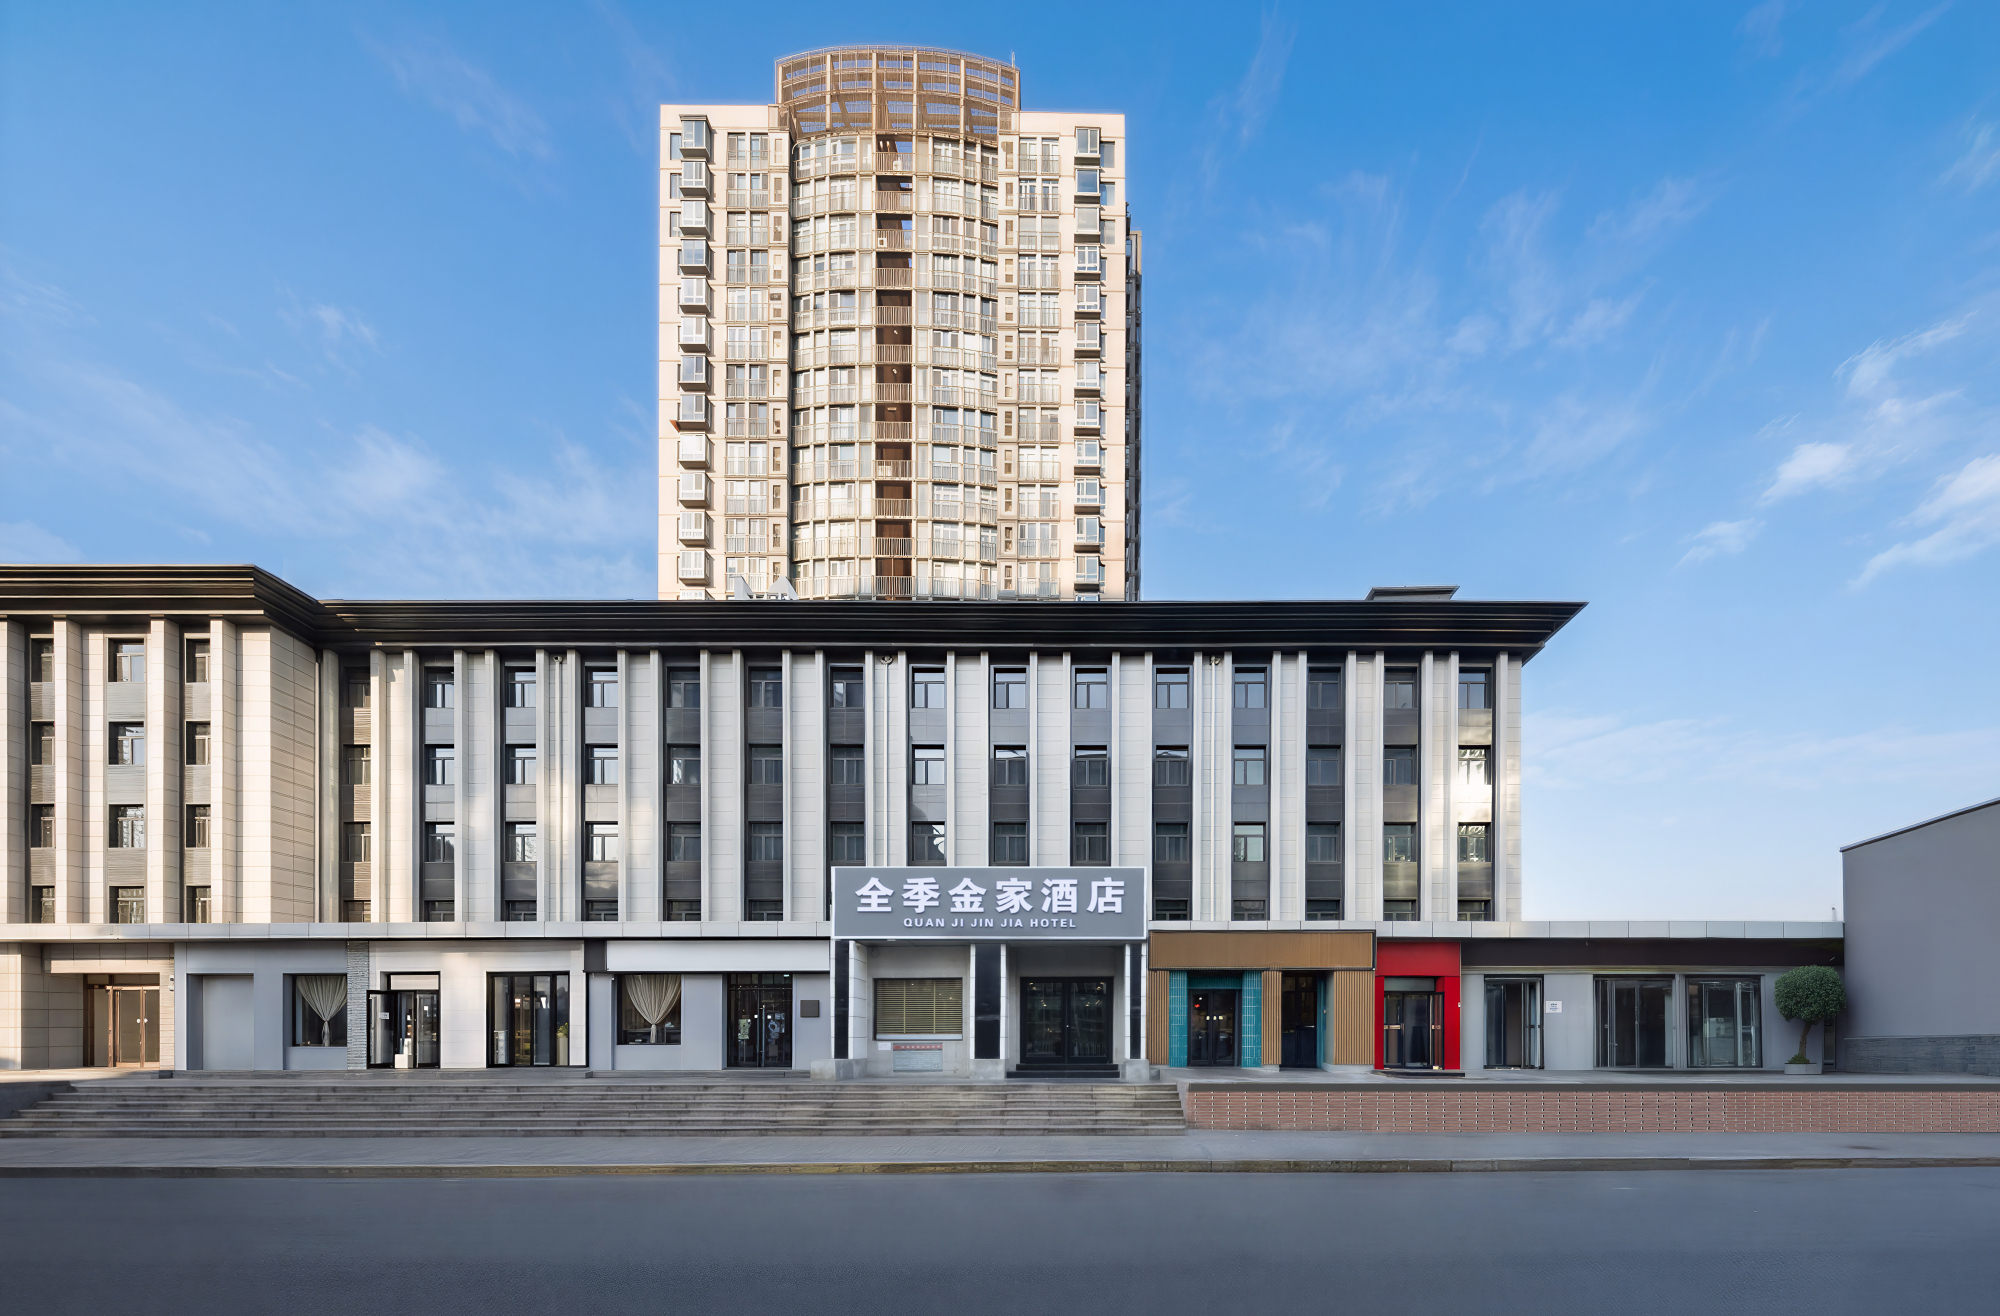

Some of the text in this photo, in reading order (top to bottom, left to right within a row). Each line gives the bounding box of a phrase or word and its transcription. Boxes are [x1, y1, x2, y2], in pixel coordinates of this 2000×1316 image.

[855, 877, 1125, 914] 全季金家酒店
[903, 918, 1076, 928] QUAN JI JIN JIA HOTEL
